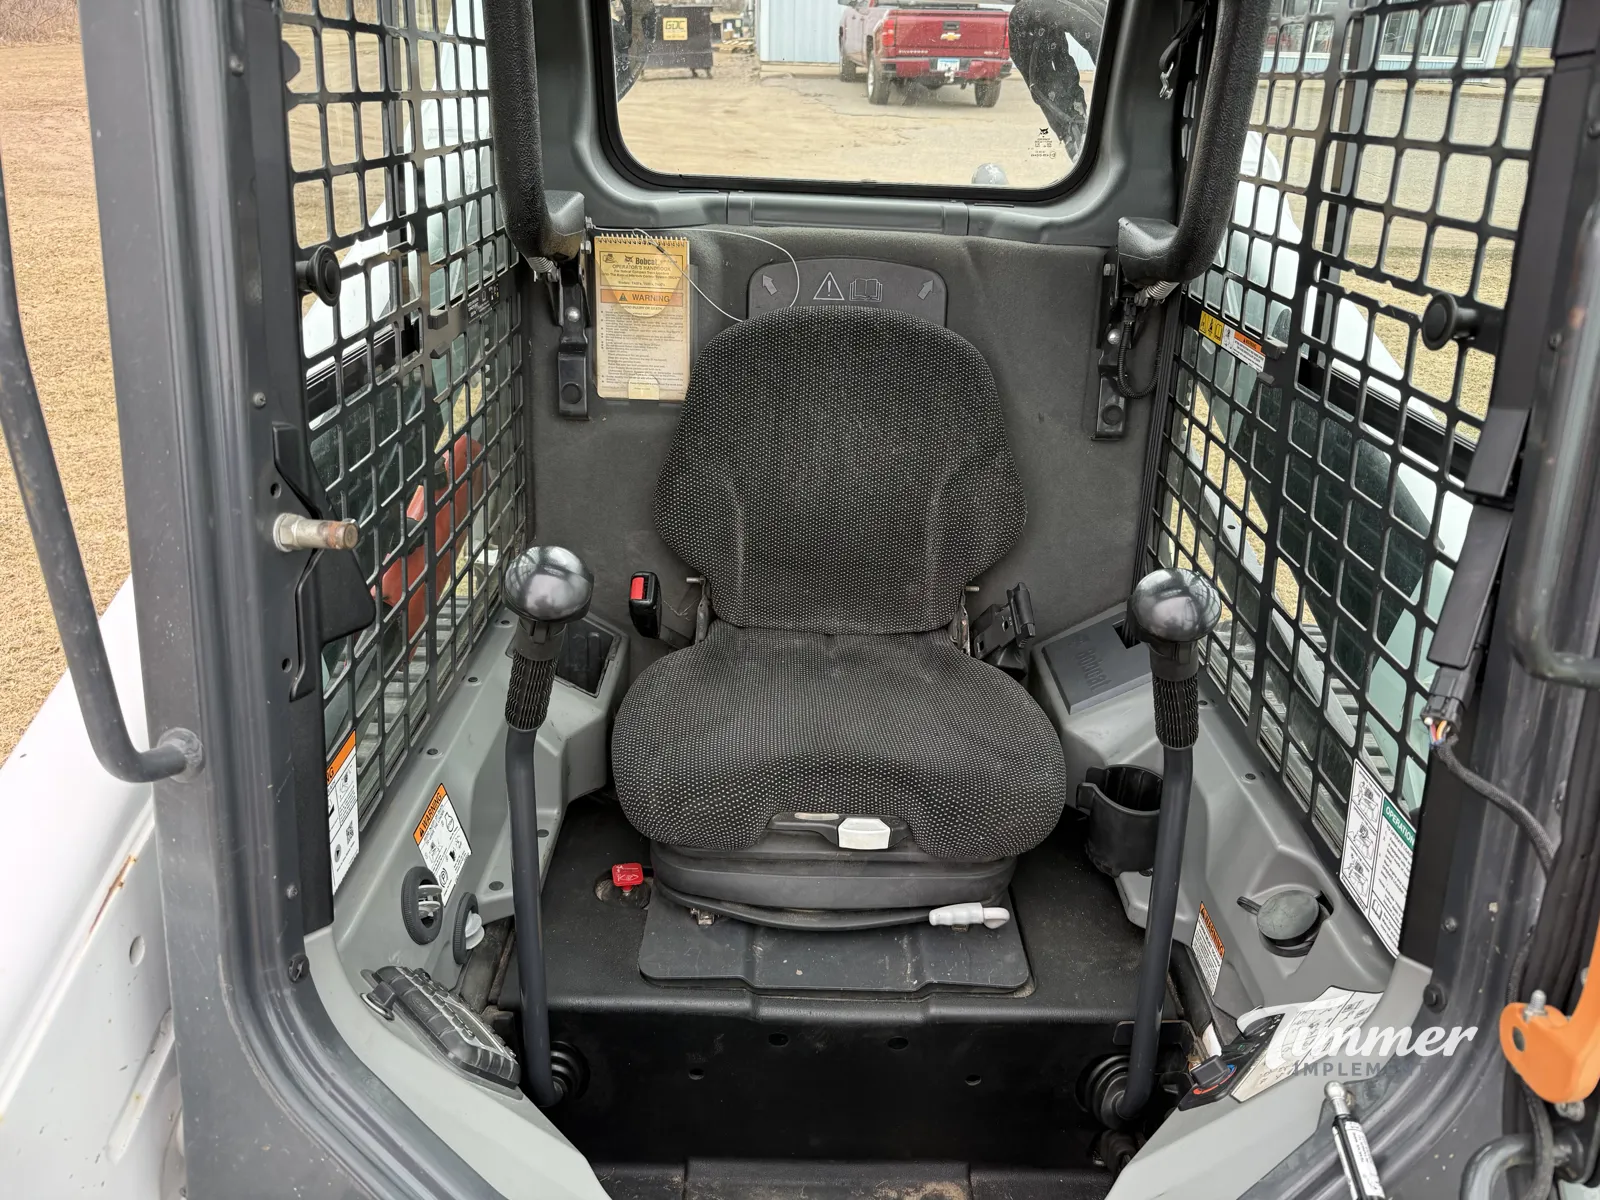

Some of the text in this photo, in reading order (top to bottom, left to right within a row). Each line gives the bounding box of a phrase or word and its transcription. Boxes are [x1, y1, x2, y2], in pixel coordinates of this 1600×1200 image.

[635, 257, 658, 265] Bobcat
[631, 293, 671, 302] WARNING
[1385, 806, 1415, 846] OPERATION
